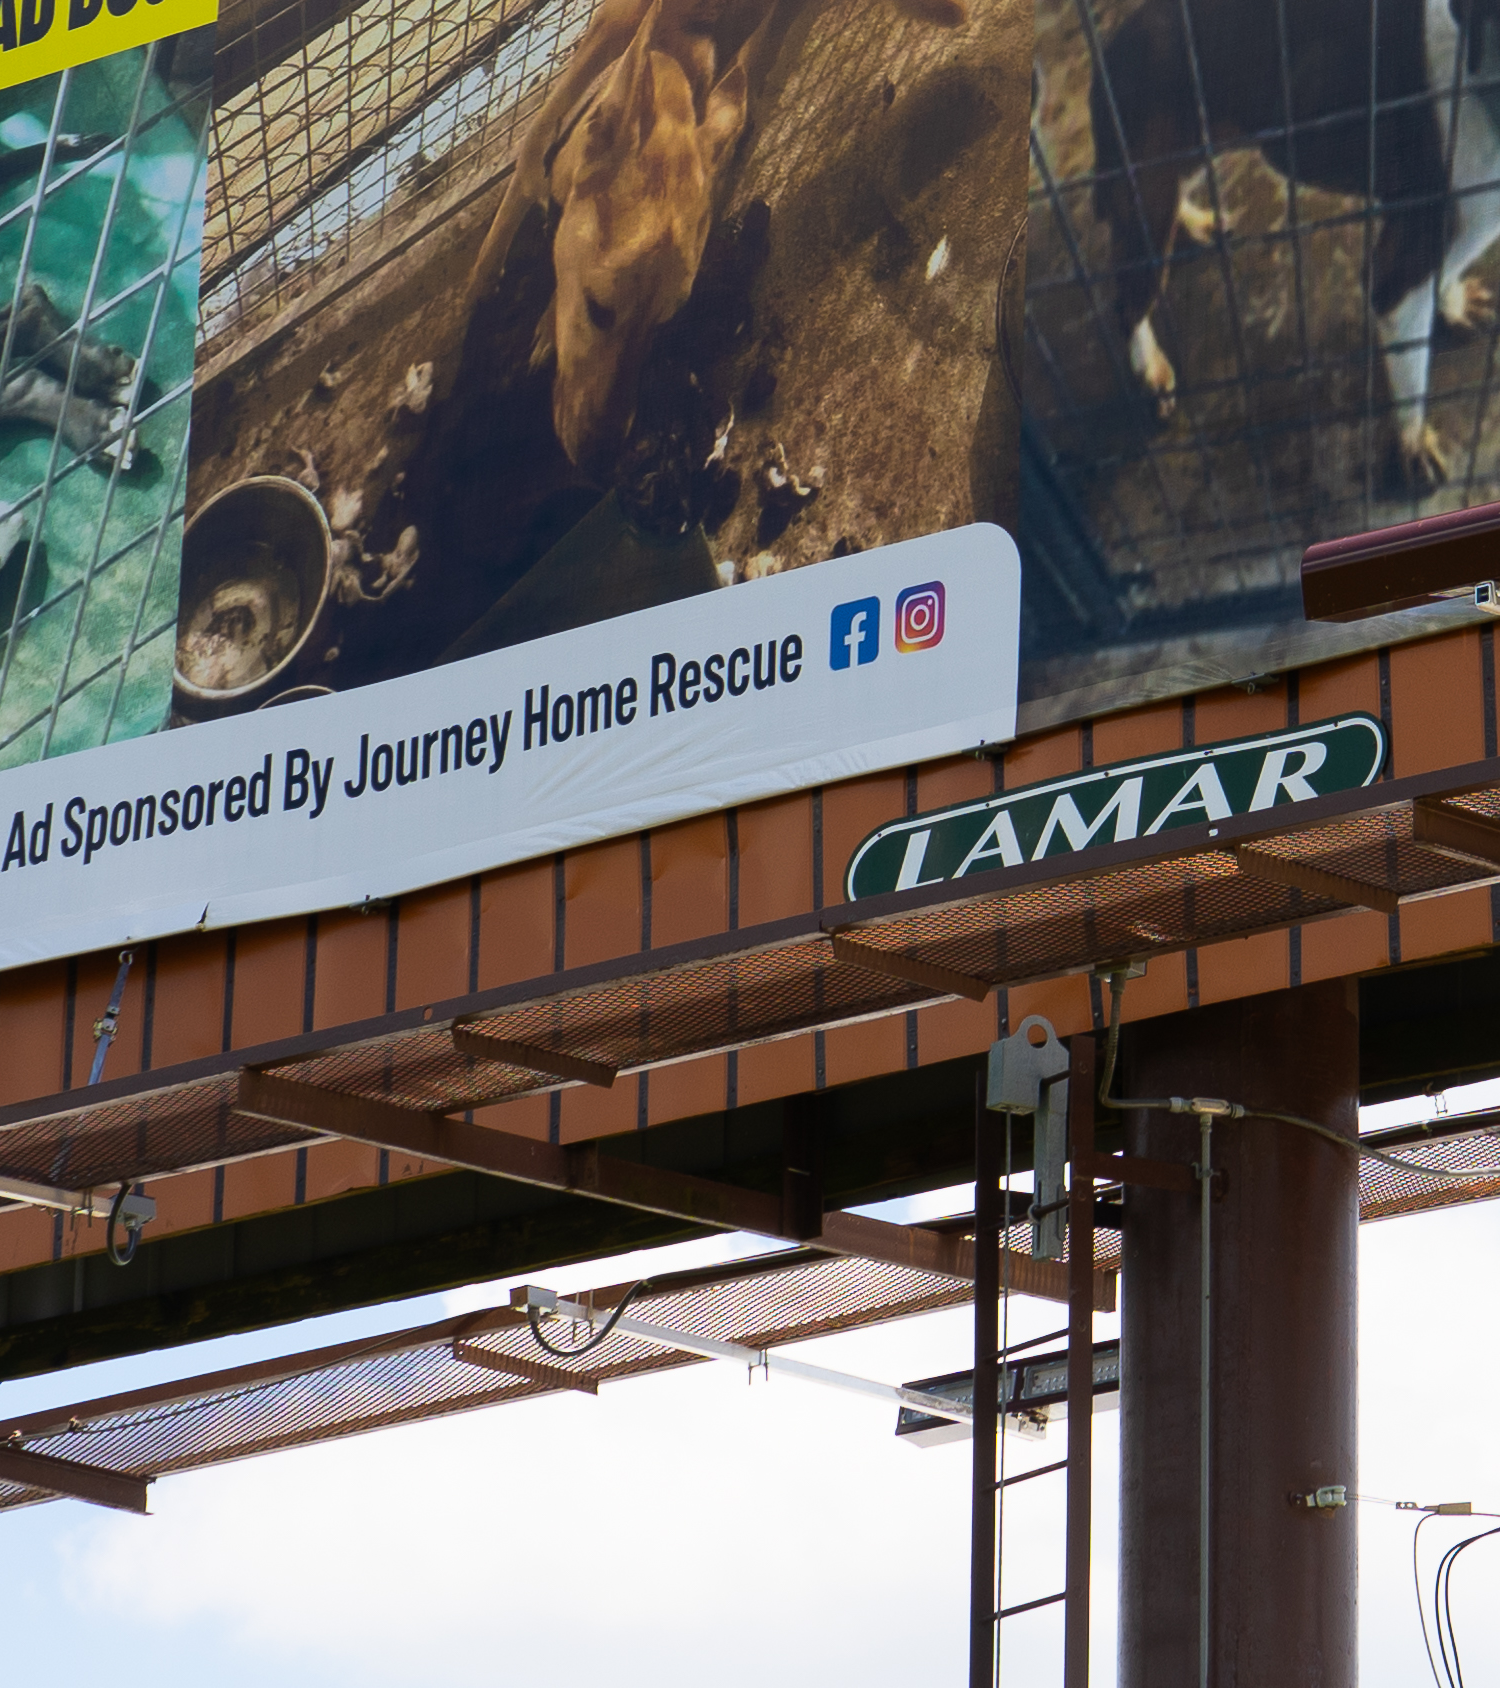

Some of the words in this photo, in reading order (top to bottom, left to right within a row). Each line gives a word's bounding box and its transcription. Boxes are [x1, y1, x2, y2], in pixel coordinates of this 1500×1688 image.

[0, 801, 56, 874] Ad
[60, 752, 274, 866] Sponsored
[282, 747, 336, 820] By
[343, 708, 514, 799] Journey
[522, 676, 639, 752] Home
[649, 633, 804, 719] Rescue
[894, 741, 1329, 893] LAMAR
